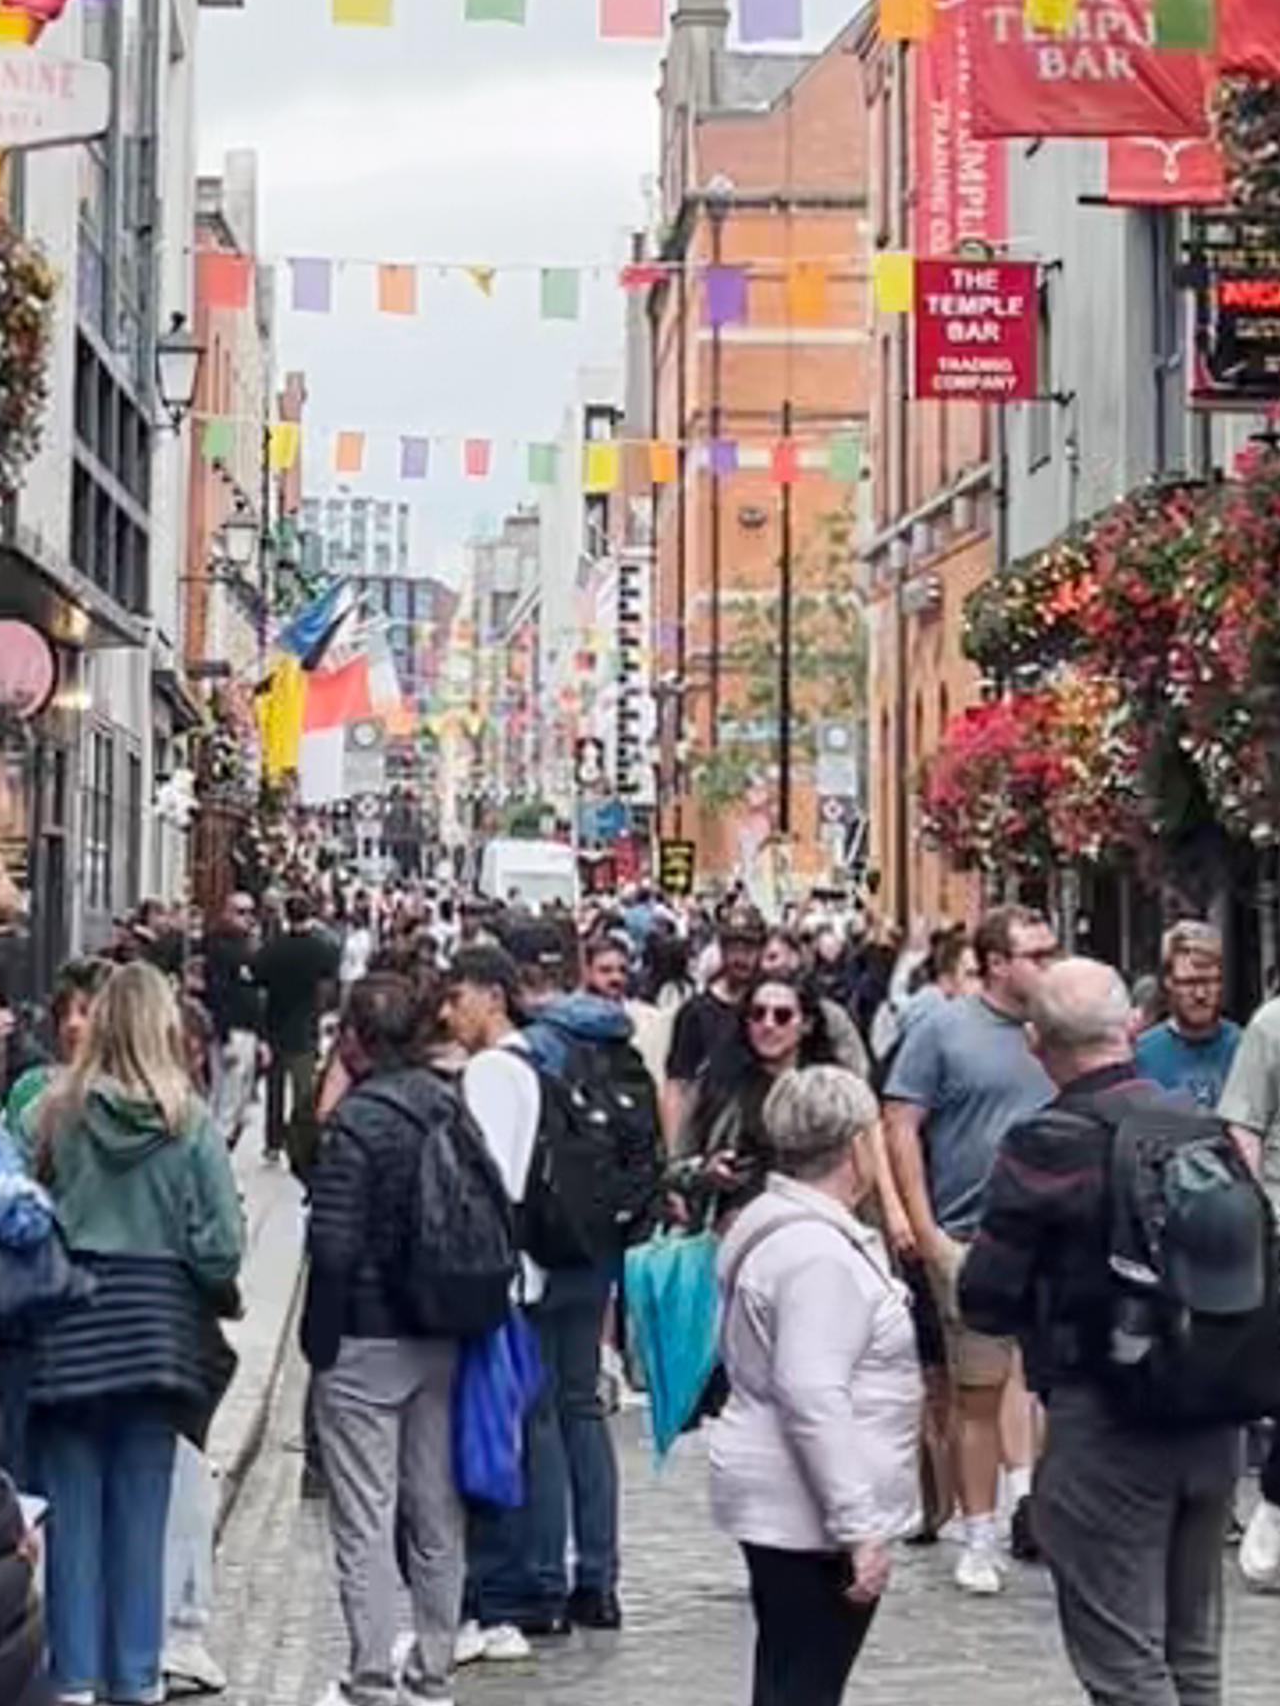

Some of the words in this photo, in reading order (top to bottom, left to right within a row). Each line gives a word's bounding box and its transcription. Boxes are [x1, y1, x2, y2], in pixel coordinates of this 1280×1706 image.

[1037, 46, 1138, 80] BAR
[2, 58, 76, 100] NINE
[951, 267, 1000, 290] THE
[927, 295, 1023, 316] TEMPLE
[946, 320, 1000, 343] BAR
[937, 356, 1013, 372] TRADING
[932, 374, 1017, 391] COMPANY
